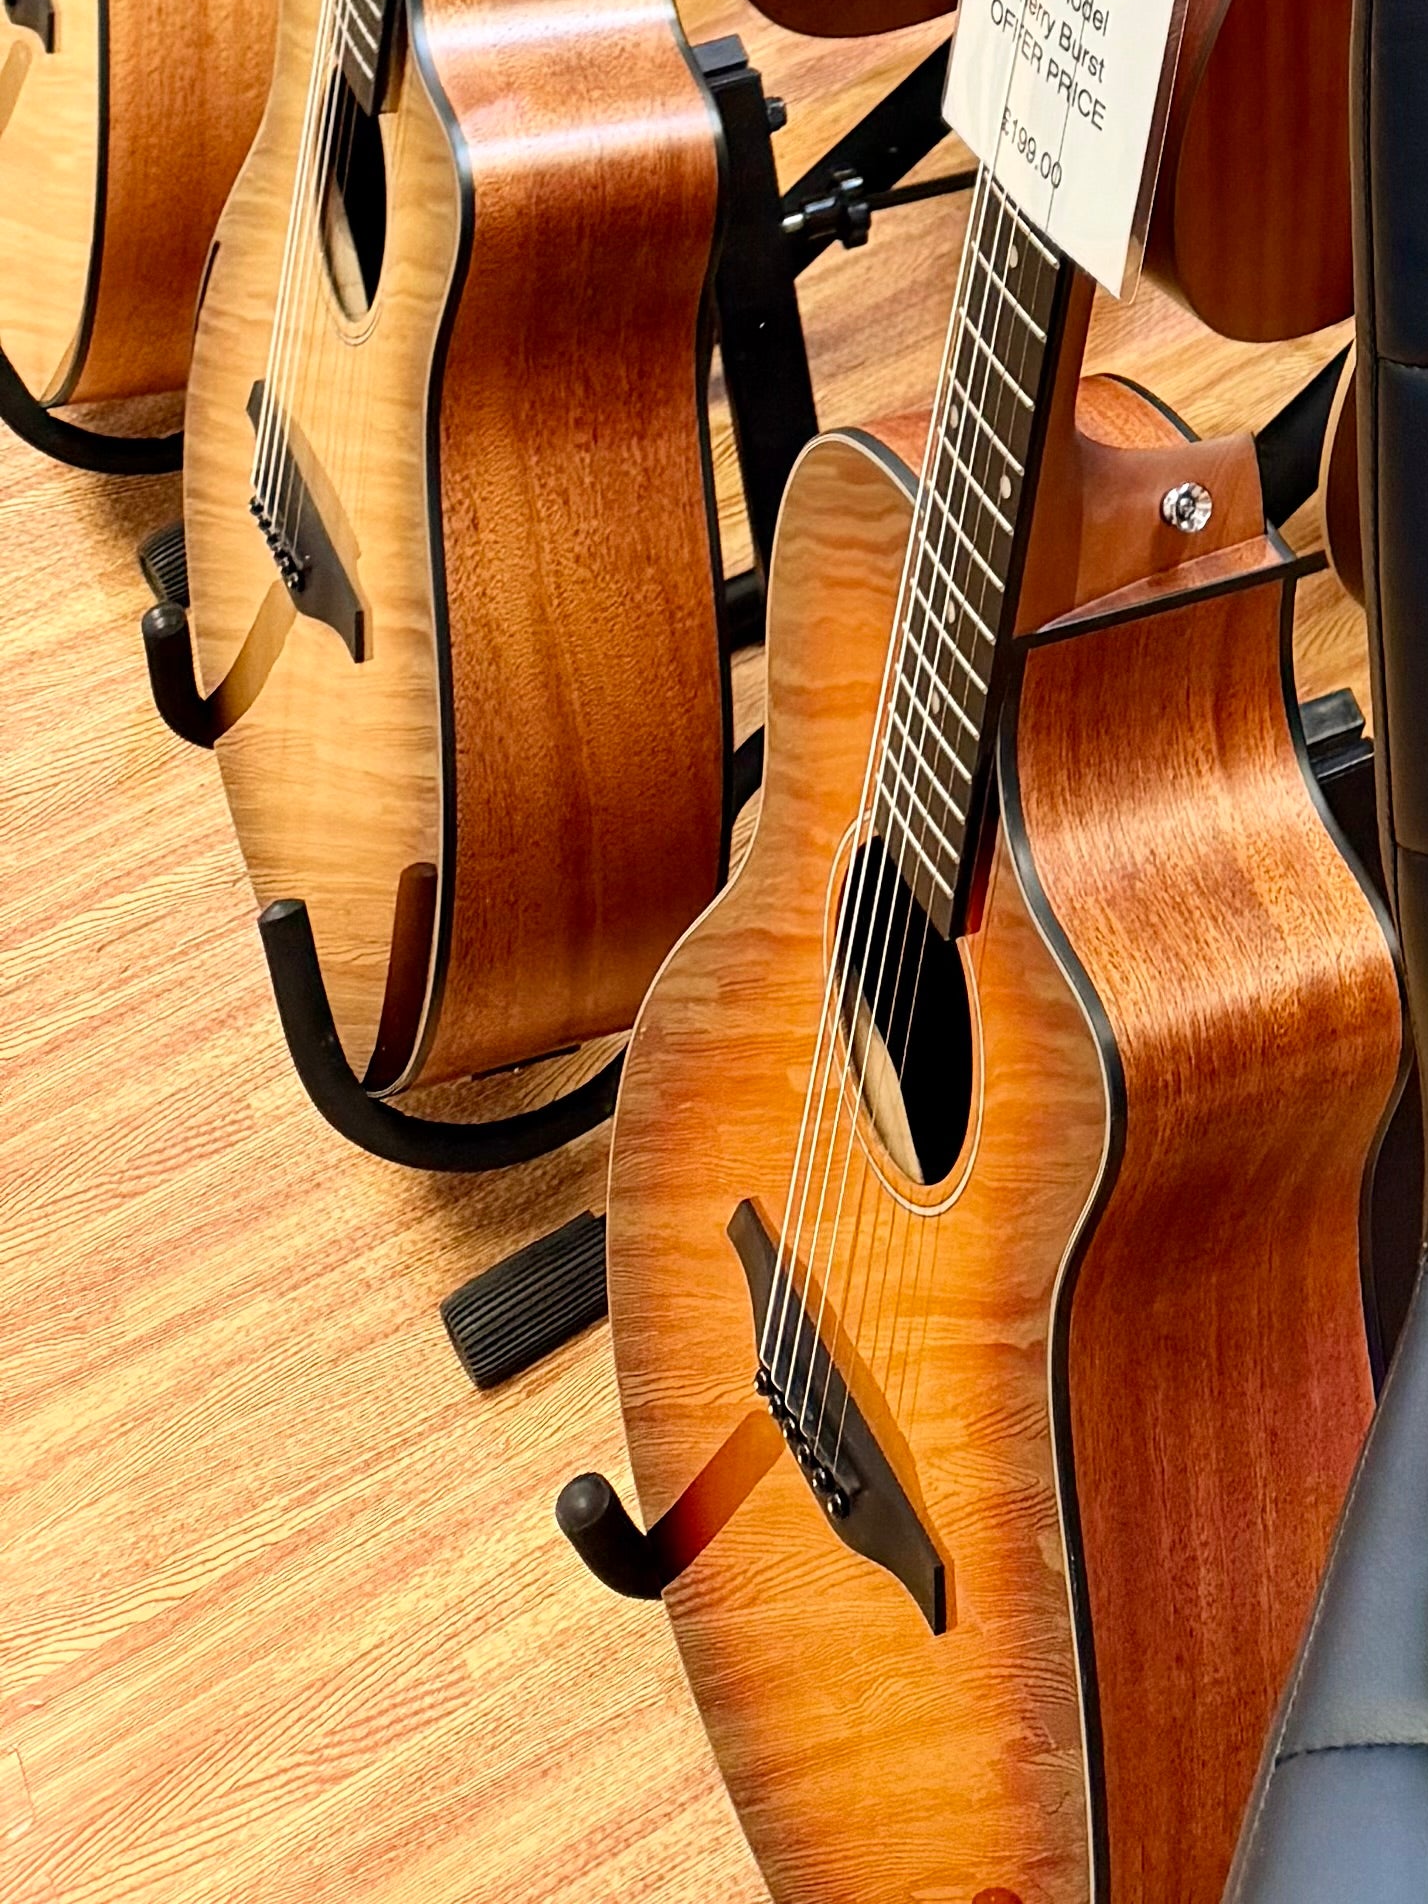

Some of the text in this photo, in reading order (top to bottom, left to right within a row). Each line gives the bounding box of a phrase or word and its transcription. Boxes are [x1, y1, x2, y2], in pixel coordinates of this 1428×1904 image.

[1057, 20, 1107, 85] Burst
[1045, 57, 1108, 133] PRICE
[1001, 105, 1064, 190] £199.00
